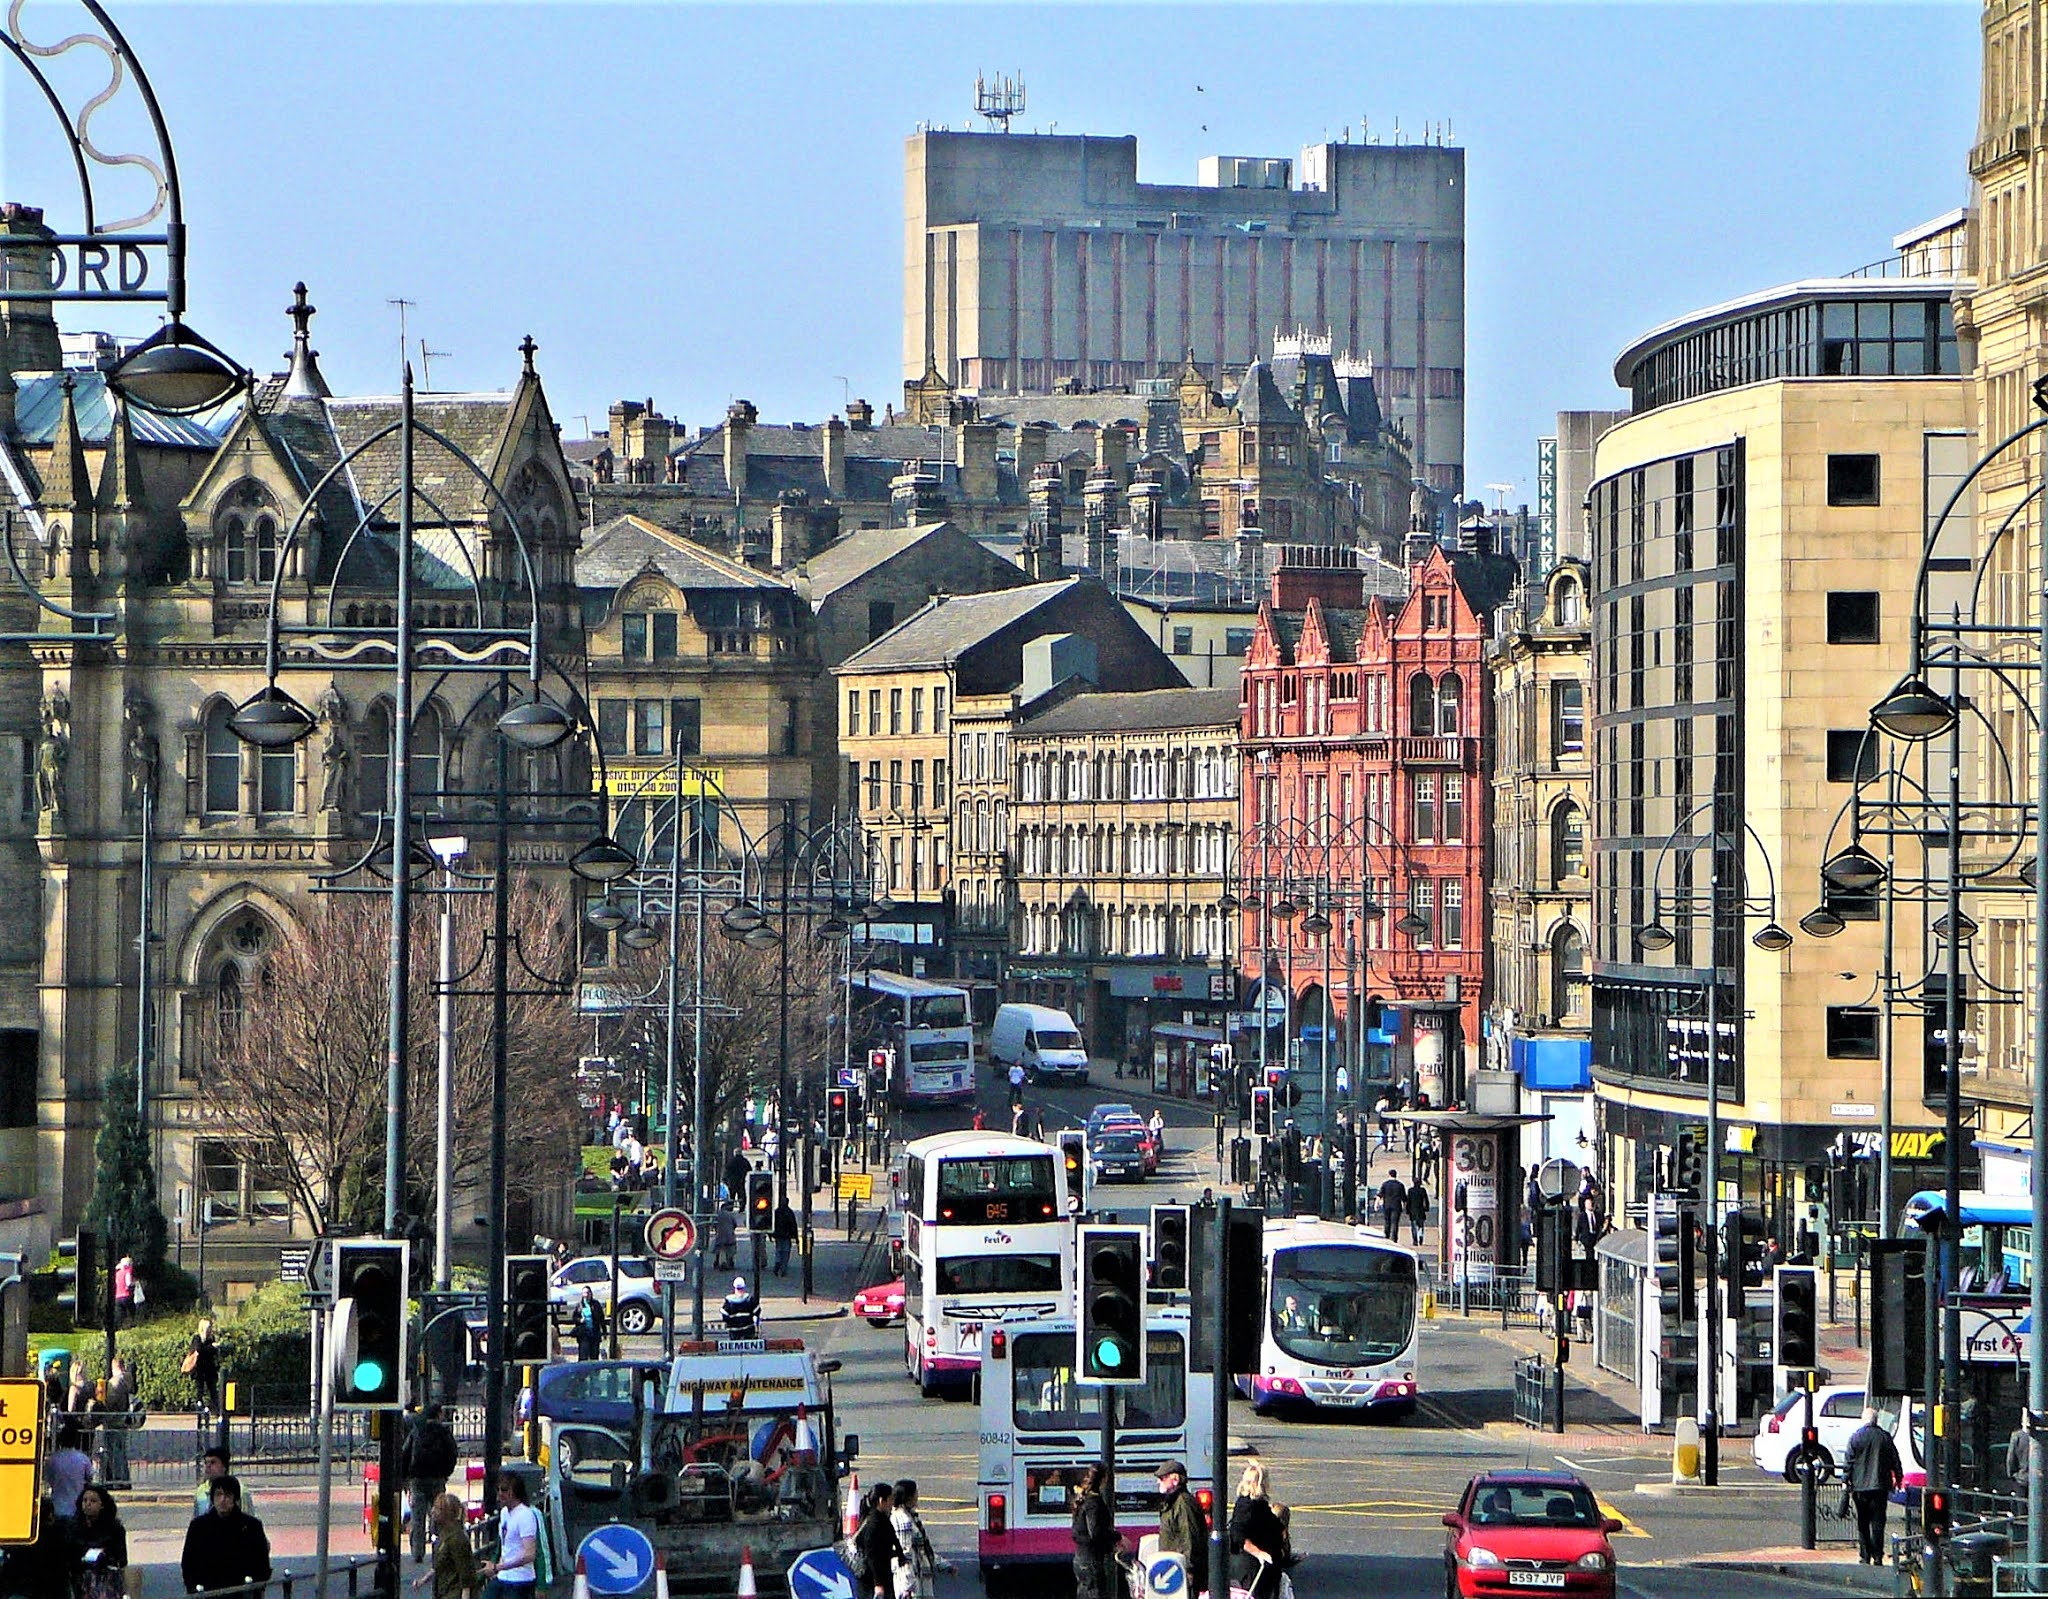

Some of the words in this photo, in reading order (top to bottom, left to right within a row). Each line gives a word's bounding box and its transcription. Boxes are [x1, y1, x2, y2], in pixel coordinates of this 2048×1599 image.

[1455, 1138, 1493, 1172] 30
[1455, 1215, 1493, 1248] 30
[719, 1341, 764, 1351] SIEMENS
[1966, 1336, 1997, 1352] First
[730, 1378, 804, 1390] MANTENANCE
[980, 1432, 1010, 1445] 60842
[1511, 1573, 1539, 1583] S597
